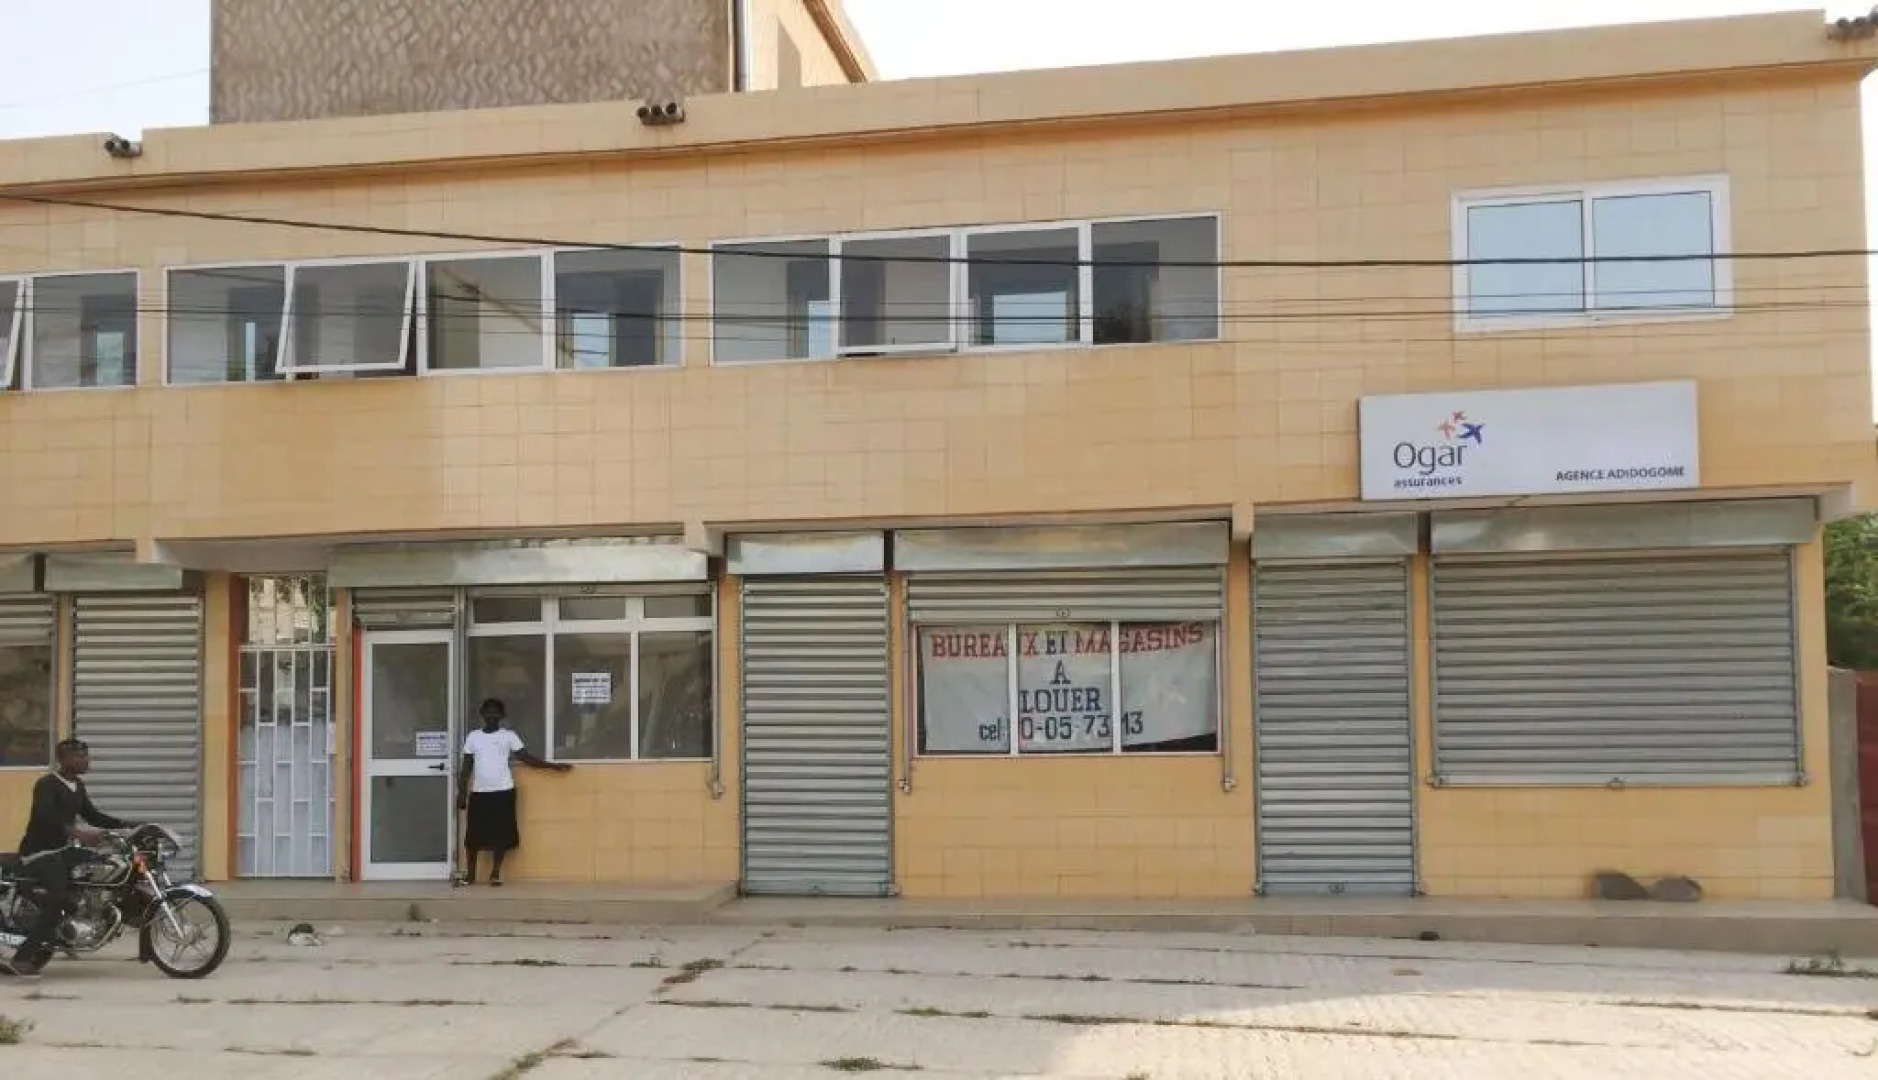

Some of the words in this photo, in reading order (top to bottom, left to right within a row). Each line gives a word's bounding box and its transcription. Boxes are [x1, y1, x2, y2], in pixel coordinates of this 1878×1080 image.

[1394, 441, 1467, 475] Ogar
[1394, 477, 1463, 488] assurances
[1556, 469, 1605, 481] AGENCE
[1607, 466, 1684, 480] ADIDOGOME
[931, 632, 1039, 657] BUREAX
[1045, 631, 1068, 655] ET
[1050, 660, 1071, 684] A
[1019, 687, 1102, 713] LOUER
